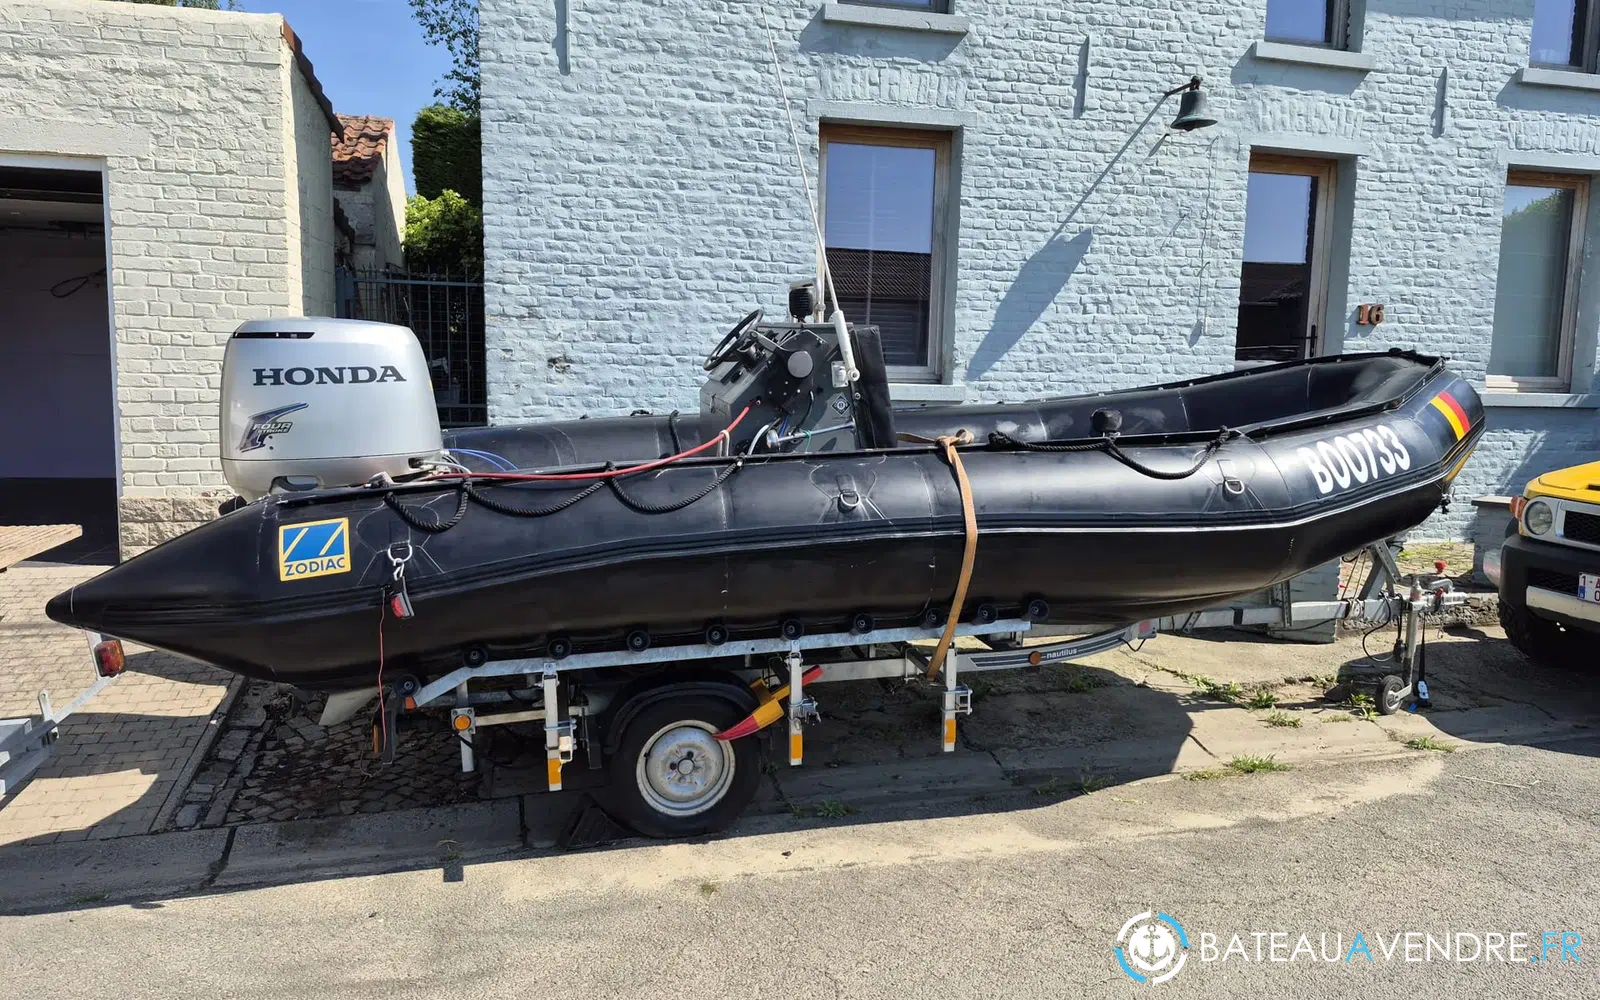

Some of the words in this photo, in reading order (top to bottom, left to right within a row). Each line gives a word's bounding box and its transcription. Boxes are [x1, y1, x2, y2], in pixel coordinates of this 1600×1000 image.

[1356, 303, 1385, 325] 16
[252, 365, 407, 386] HONDA
[252, 422, 292, 430] FOUR
[284, 557, 345, 576] ZODIAC
[1046, 648, 1078, 659] nautilus
